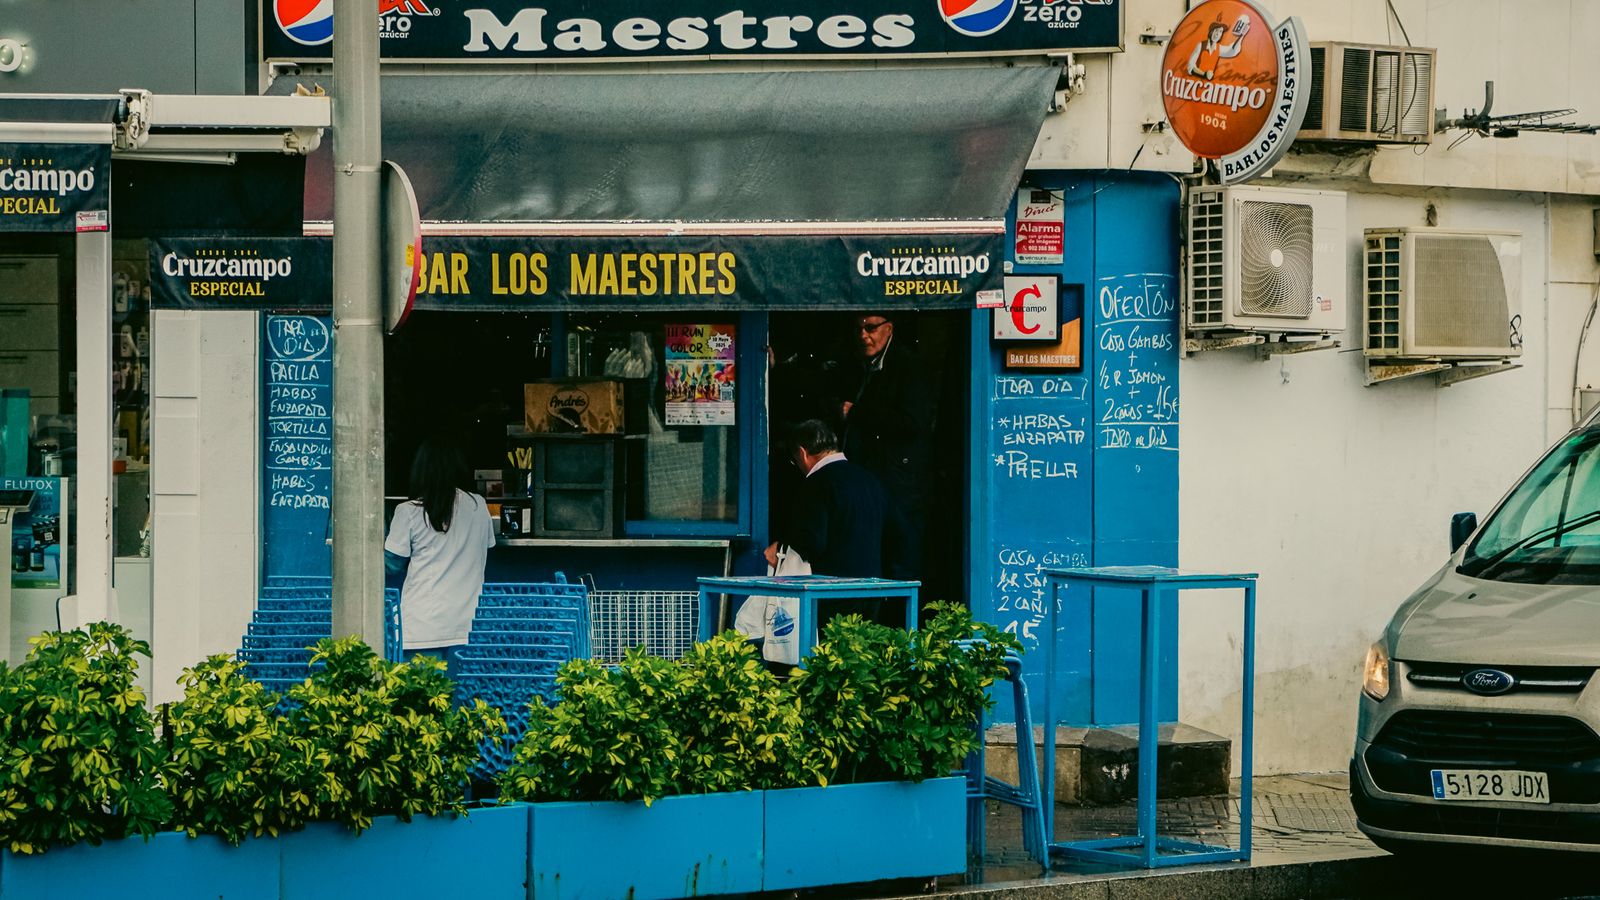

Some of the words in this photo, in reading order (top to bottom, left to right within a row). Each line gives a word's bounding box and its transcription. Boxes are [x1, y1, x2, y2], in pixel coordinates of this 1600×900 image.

[1023, 6, 1082, 21] zero
[463, 8, 915, 52] Maestres
[1047, 20, 1079, 28] azúcar
[380, 30, 409, 38] azúcar
[1164, 69, 1267, 112] Cruzcampo
[1225, 154, 1255, 176] BAR
[1254, 130, 1278, 162] LOS
[1274, 27, 1296, 132] MAESTRES
[1201, 114, 1227, 130] 1904
[1019, 223, 1061, 233] Alarma
[162, 251, 292, 281] Cruzcampo
[857, 250, 990, 279] Cruzcampo
[492, 253, 548, 295] LOS
[570, 252, 736, 295] MAESTRES
[190, 282, 265, 296] ESPECIAL
[885, 280, 963, 295] ESPECIAL
[1005, 305, 1047, 313] Cruzcampo
[273, 319, 306, 338] TAPA
[682, 327, 704, 338] RUN
[670, 343, 704, 354] COLOR
[1010, 354, 1024, 363] BAR
[1025, 354, 1039, 363] LOS
[1040, 354, 1076, 364] MAESTRES
[270, 386, 317, 400] HABAS
[998, 378, 1034, 395] TAPA
[550, 395, 586, 408] Andrés
[1005, 450, 1078, 479] PAELLA
[5, 480, 53, 490] FLUTOX
[1472, 672, 1500, 687] Ford
[1446, 774, 1503, 795] 5128
[1512, 775, 1545, 798] JDX
